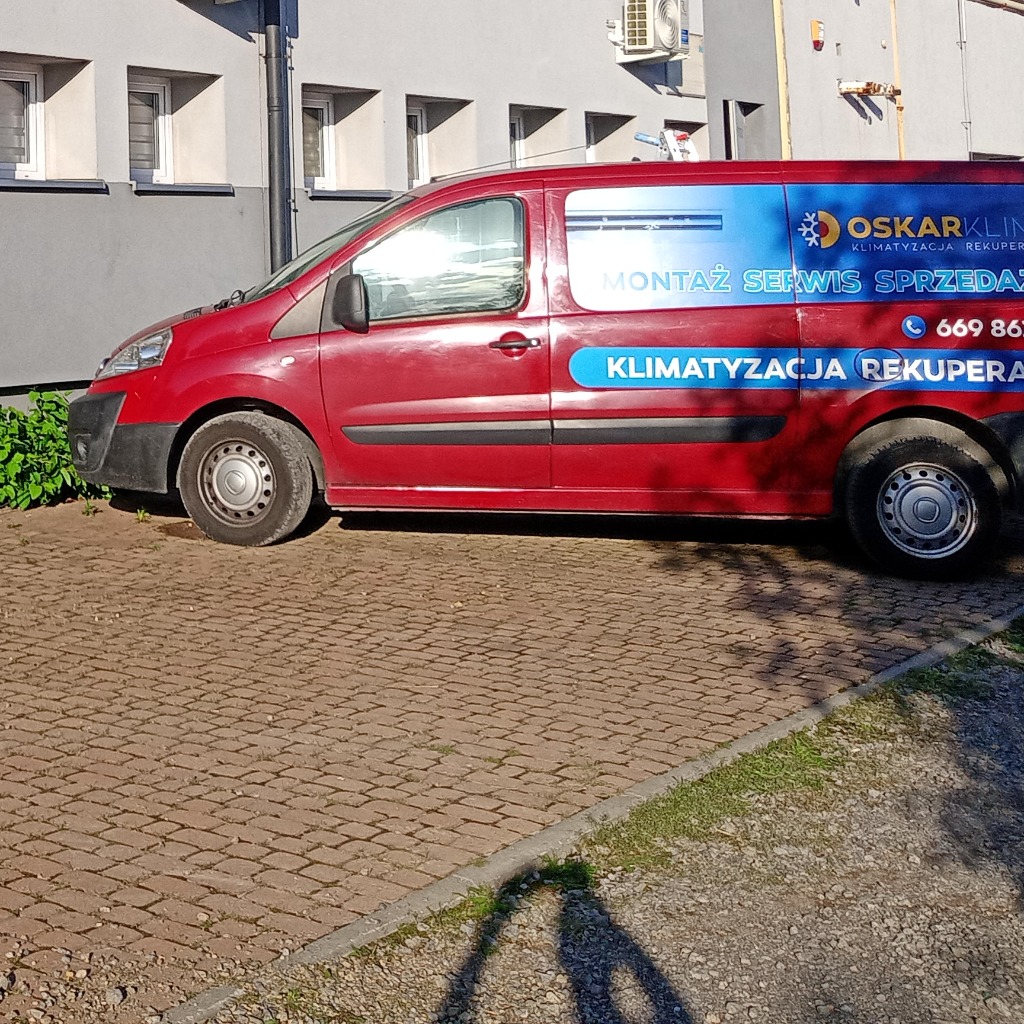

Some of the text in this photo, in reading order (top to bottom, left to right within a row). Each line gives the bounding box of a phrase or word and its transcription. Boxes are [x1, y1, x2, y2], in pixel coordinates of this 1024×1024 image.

[851, 242, 954, 252] KLIMATYZACJA
[602, 263, 1024, 294] MONTAŻ SERWIS SPRZEDA
[936, 318, 1024, 337] 669 86
[606, 356, 847, 381] KLIMATYZACJA
